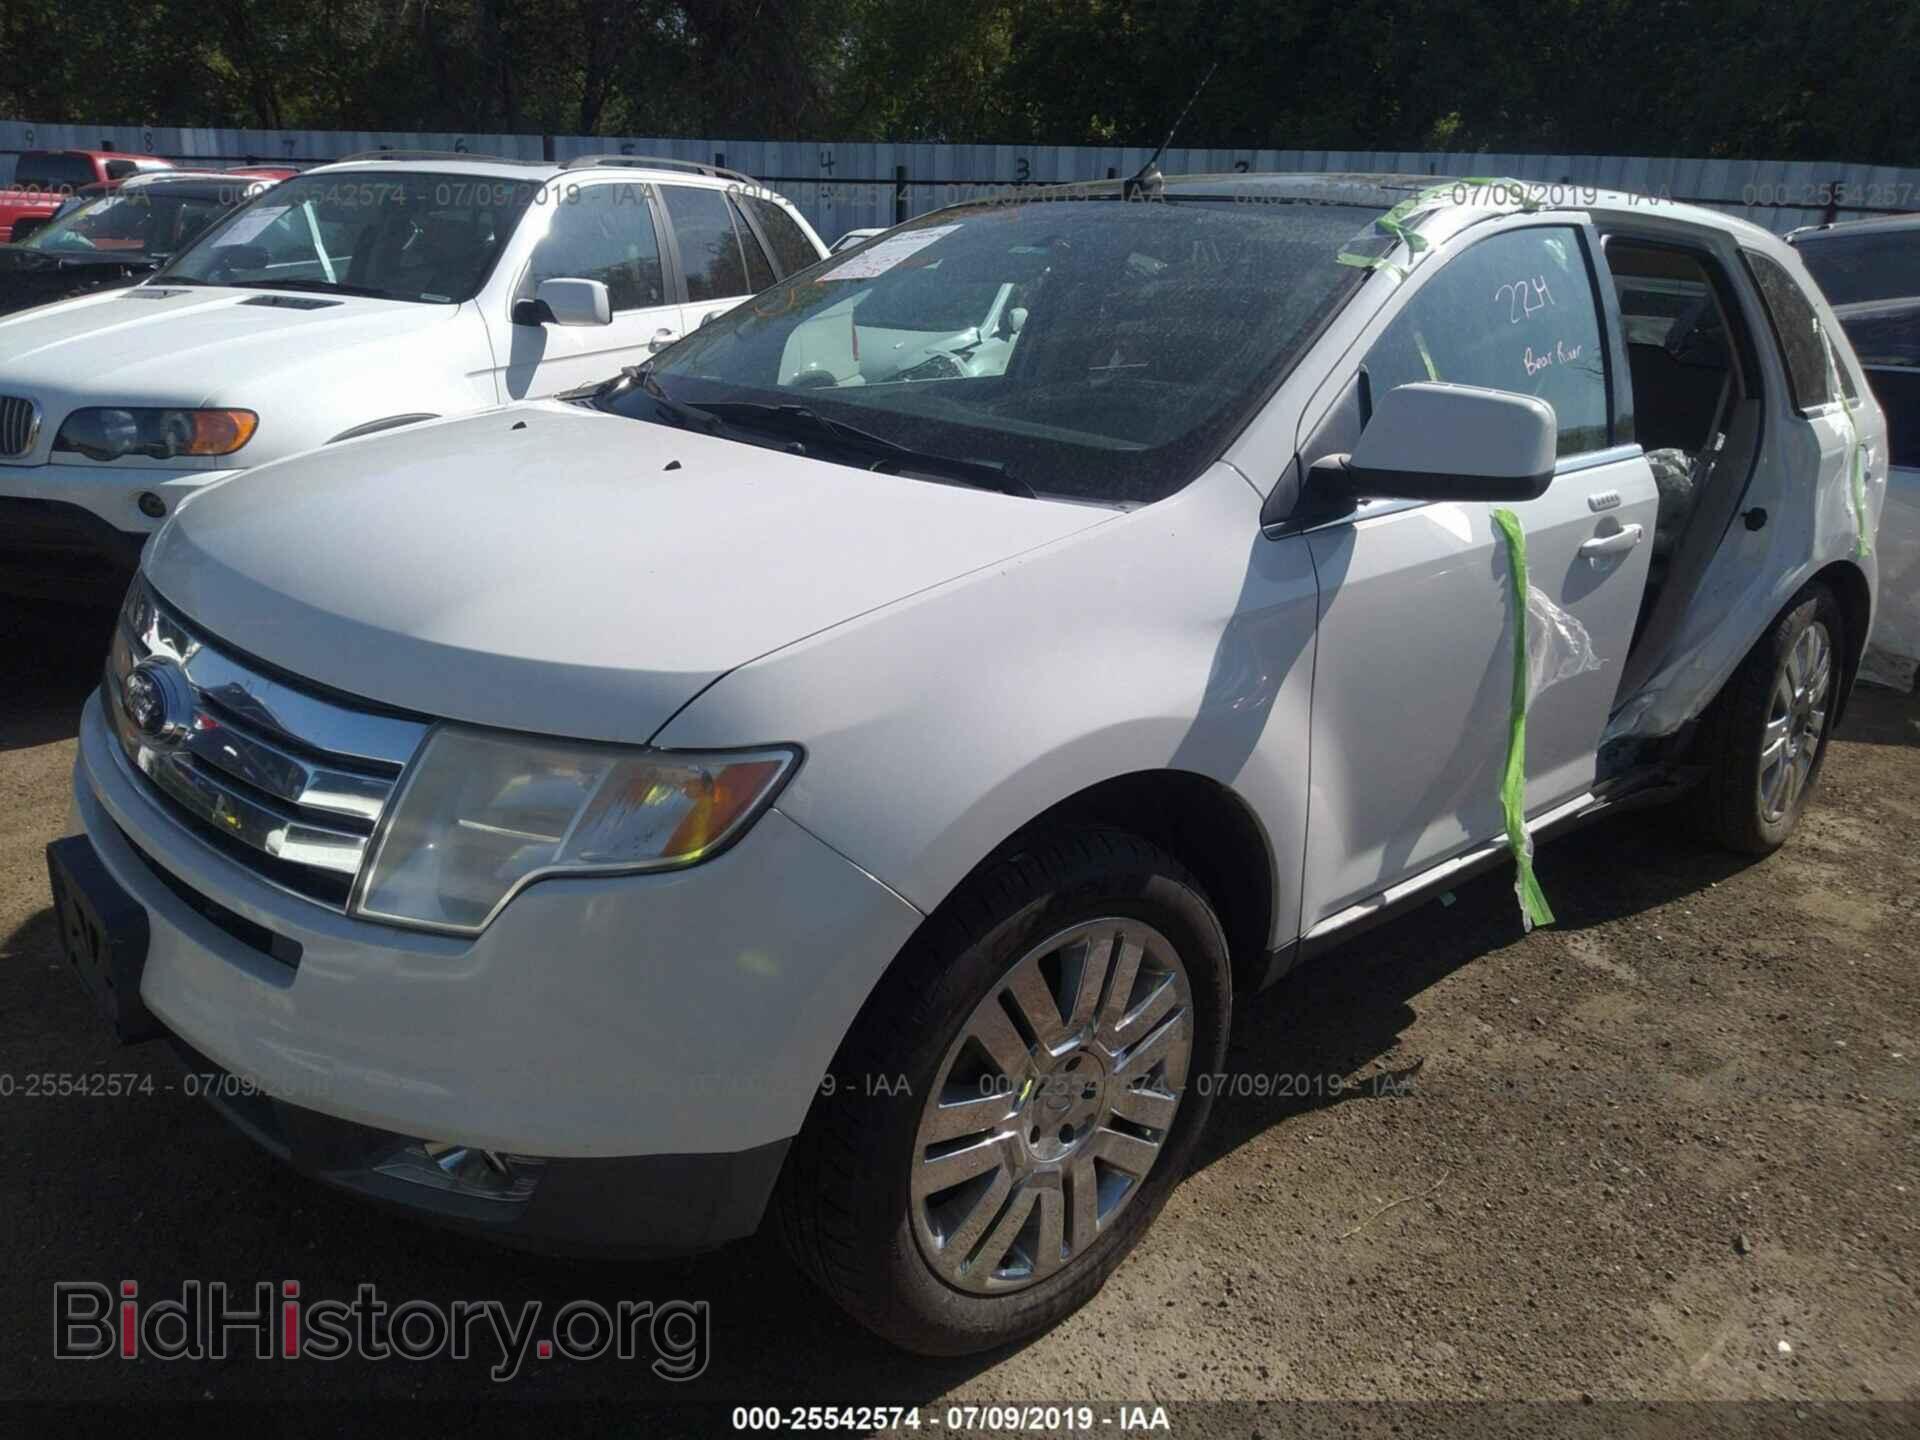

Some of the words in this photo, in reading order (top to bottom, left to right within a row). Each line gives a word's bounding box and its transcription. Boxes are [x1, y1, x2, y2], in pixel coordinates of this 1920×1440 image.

[25, 131, 34, 147] 9
[144, 132, 153, 152] 8
[283, 140, 295, 157] 7
[821, 152, 835, 175] 4
[1016, 158, 1031, 180] 3
